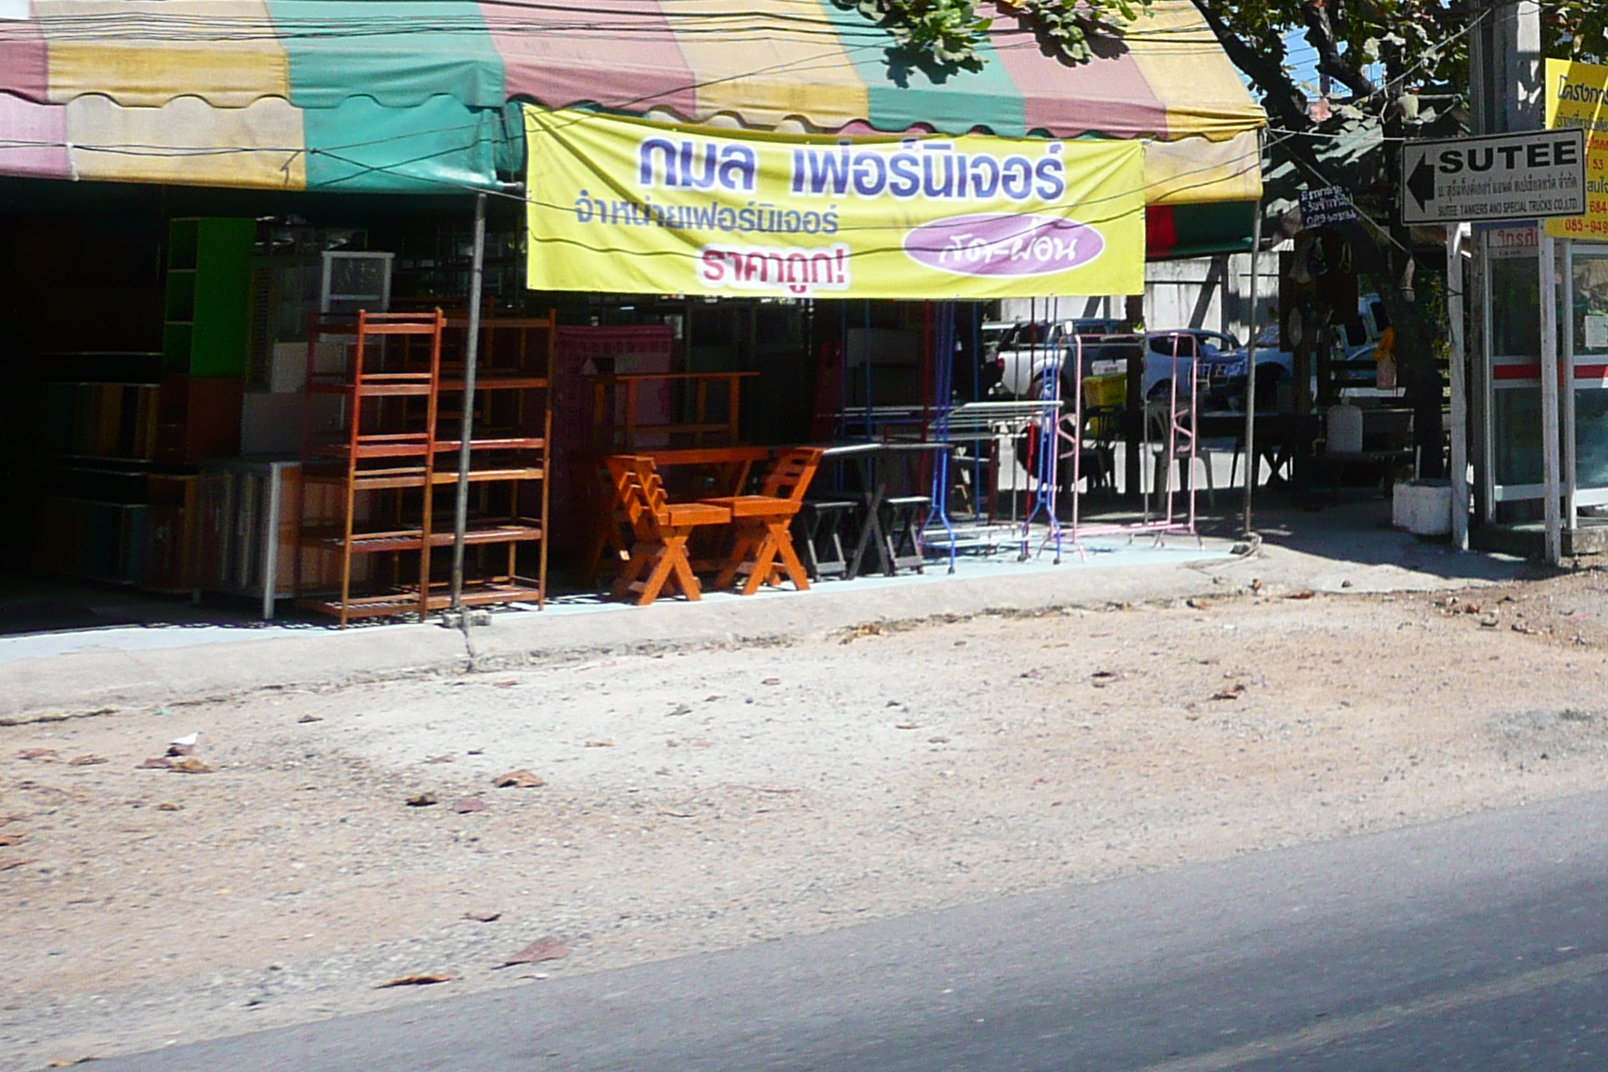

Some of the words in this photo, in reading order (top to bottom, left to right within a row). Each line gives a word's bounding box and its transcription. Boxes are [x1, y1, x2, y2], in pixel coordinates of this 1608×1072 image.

[638, 137, 757, 191] กมล
[791, 139, 1067, 201] เฟอร์นิเจอร์
[1438, 140, 1578, 174] SUTEE
[575, 189, 840, 234] จำหน่ายเฟอร์นิเจอร์
[1438, 204, 1458, 217] SUTEE
[1460, 203, 1488, 216] TANKERS
[1489, 202, 1502, 214] AND
[1503, 200, 1528, 213] SPECIAL
[702, 249, 845, 294] ราคาถูก!
